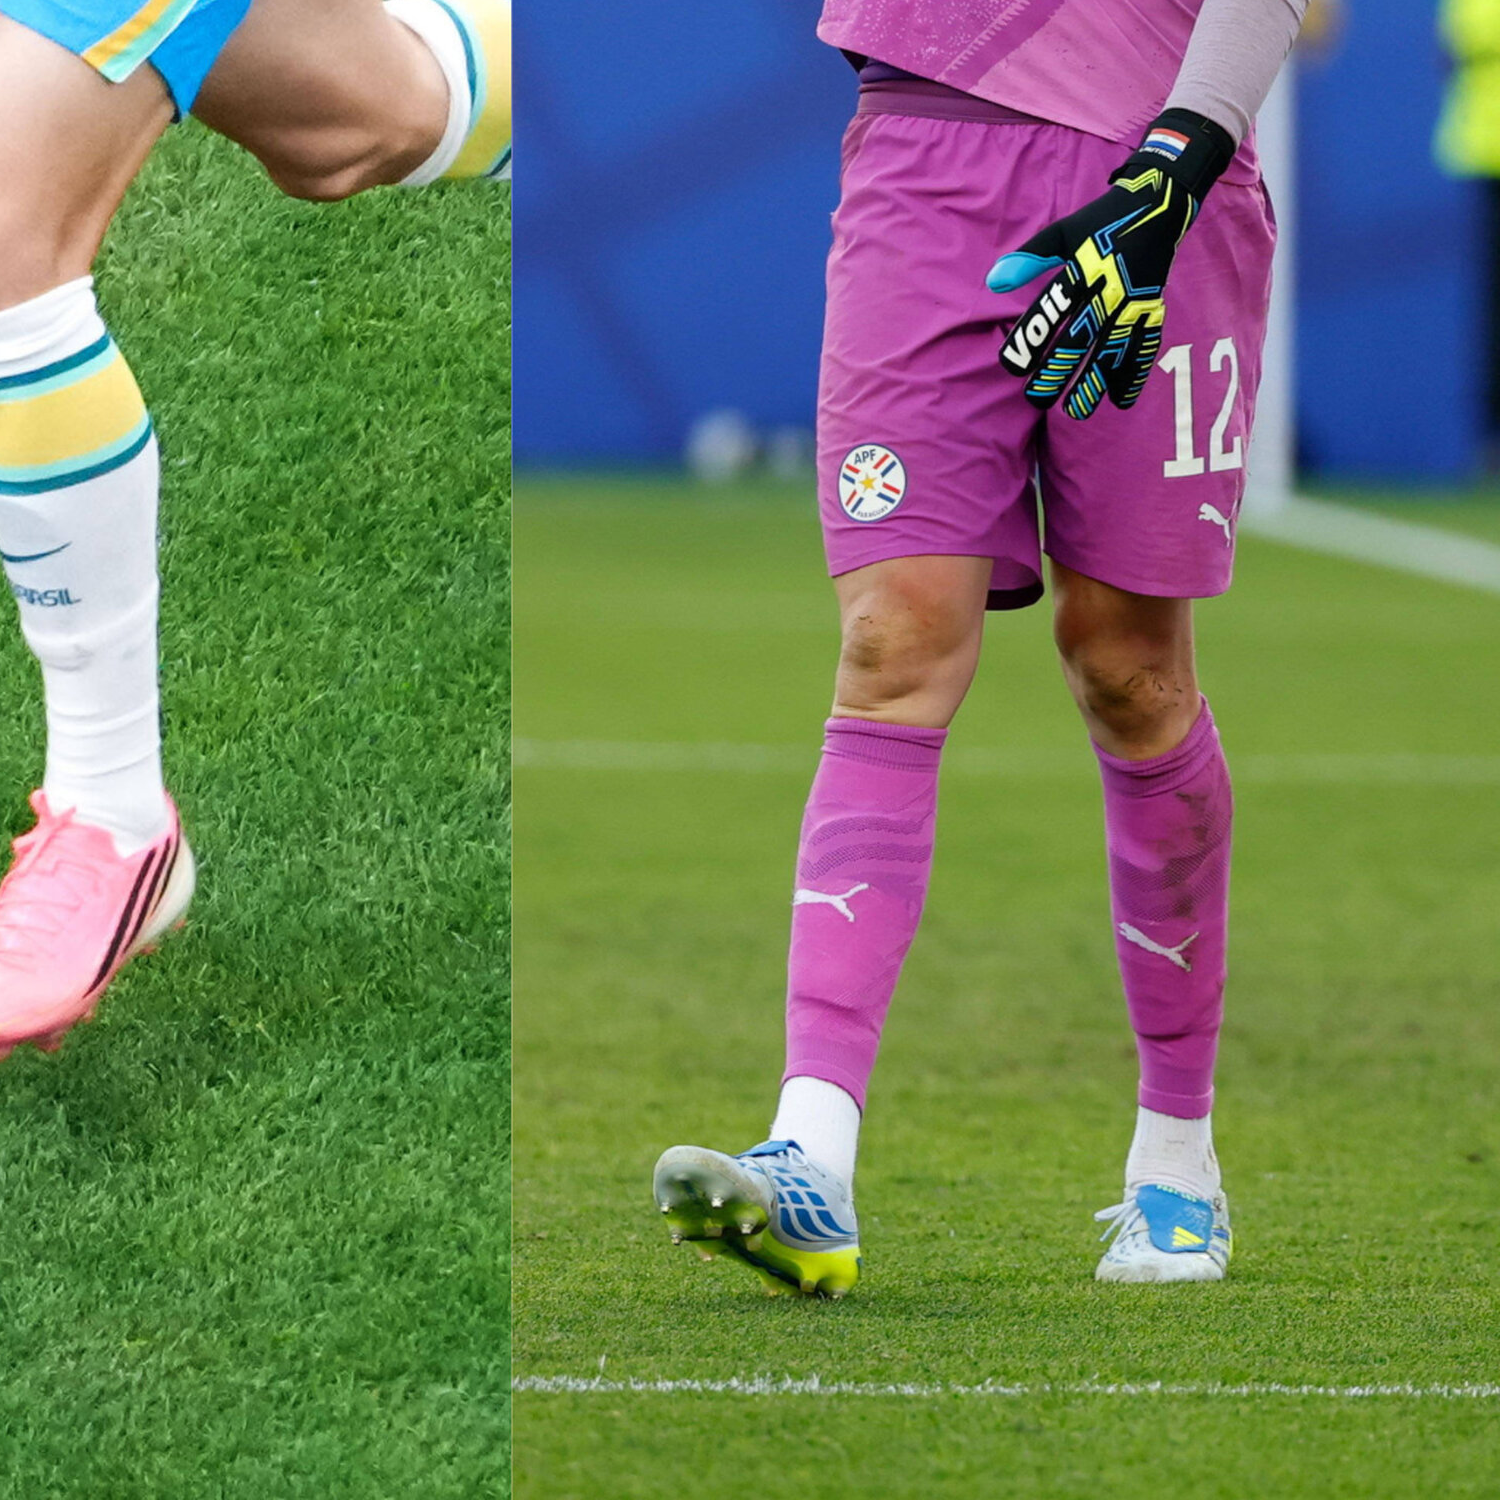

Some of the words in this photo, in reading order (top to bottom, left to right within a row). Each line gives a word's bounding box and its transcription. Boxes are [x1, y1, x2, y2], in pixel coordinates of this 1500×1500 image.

[1002, 282, 1073, 370] Voit
[1157, 336, 1244, 479] 12
[854, 449, 876, 465] APF
